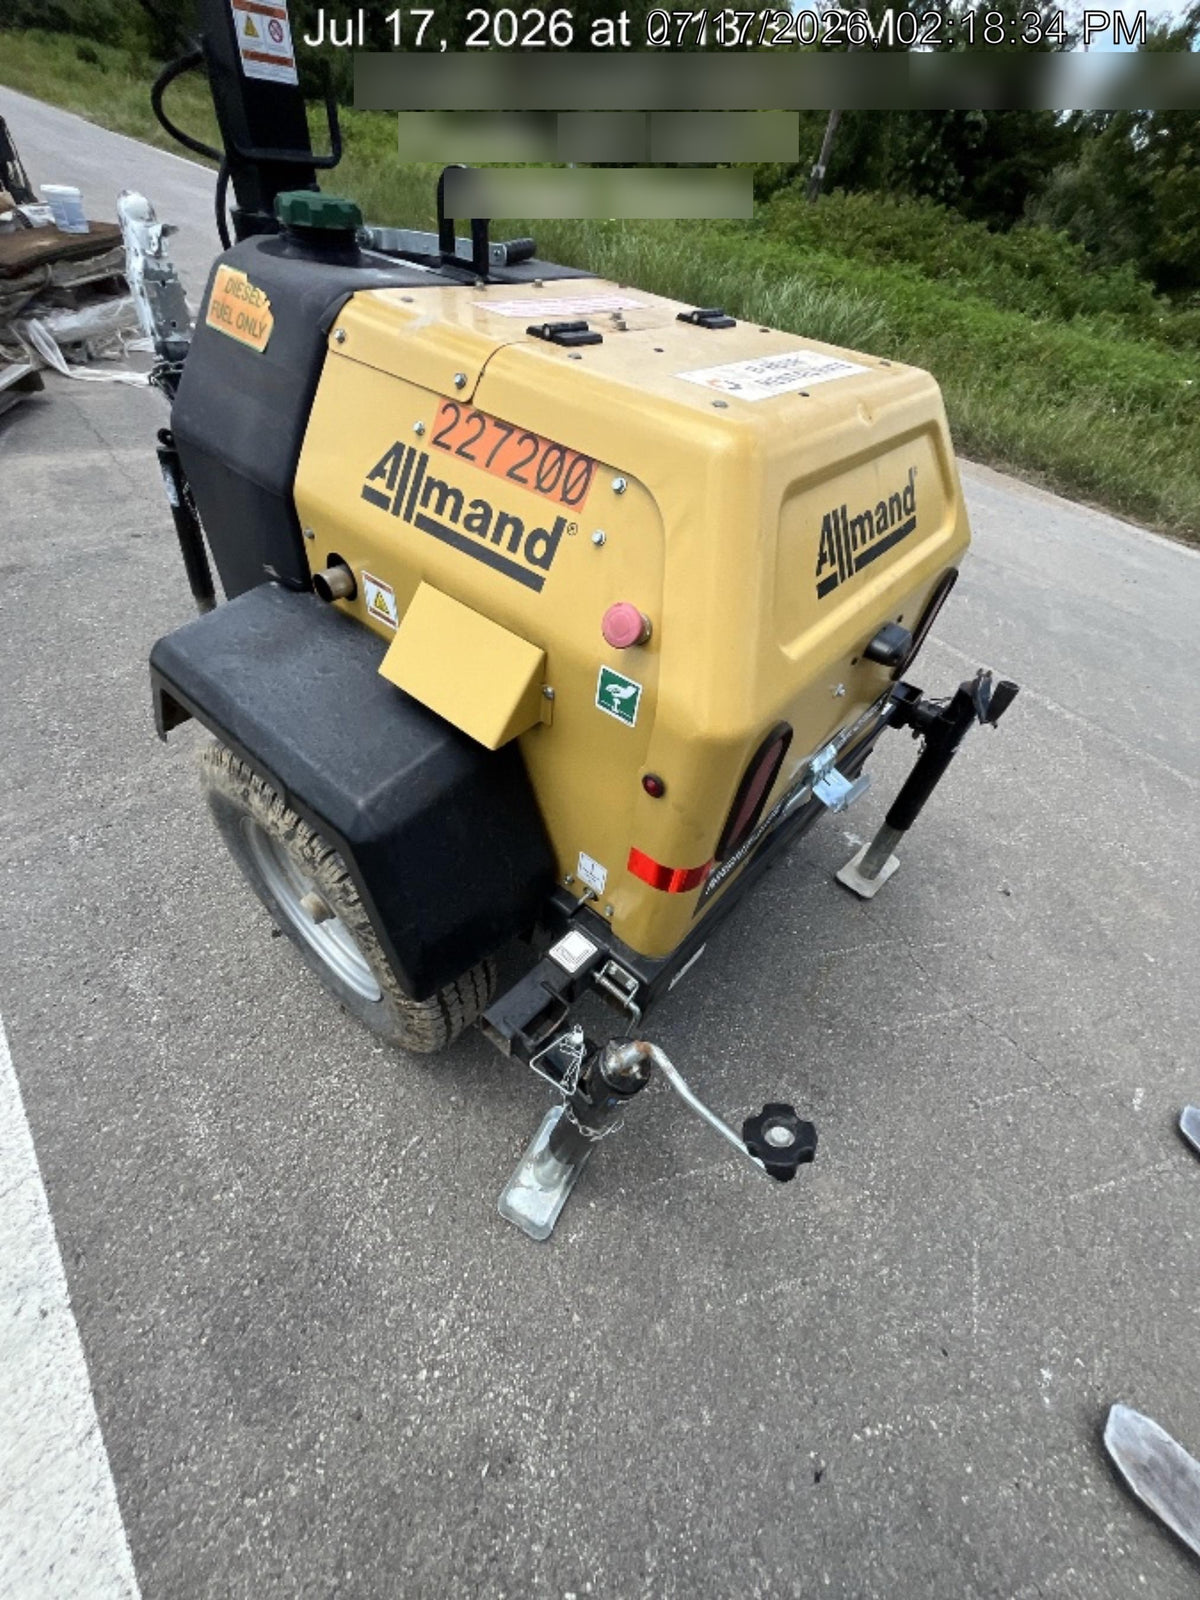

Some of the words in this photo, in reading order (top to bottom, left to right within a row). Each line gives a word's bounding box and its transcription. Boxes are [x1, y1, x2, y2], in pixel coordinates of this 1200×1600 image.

[210, 299, 233, 325] FUEL
[236, 311, 267, 339] ONLY
[223, 277, 263, 308] DIESEL
[365, 440, 568, 571] Allmand
[431, 402, 593, 506] 227200
[816, 466, 917, 583] Allmand
